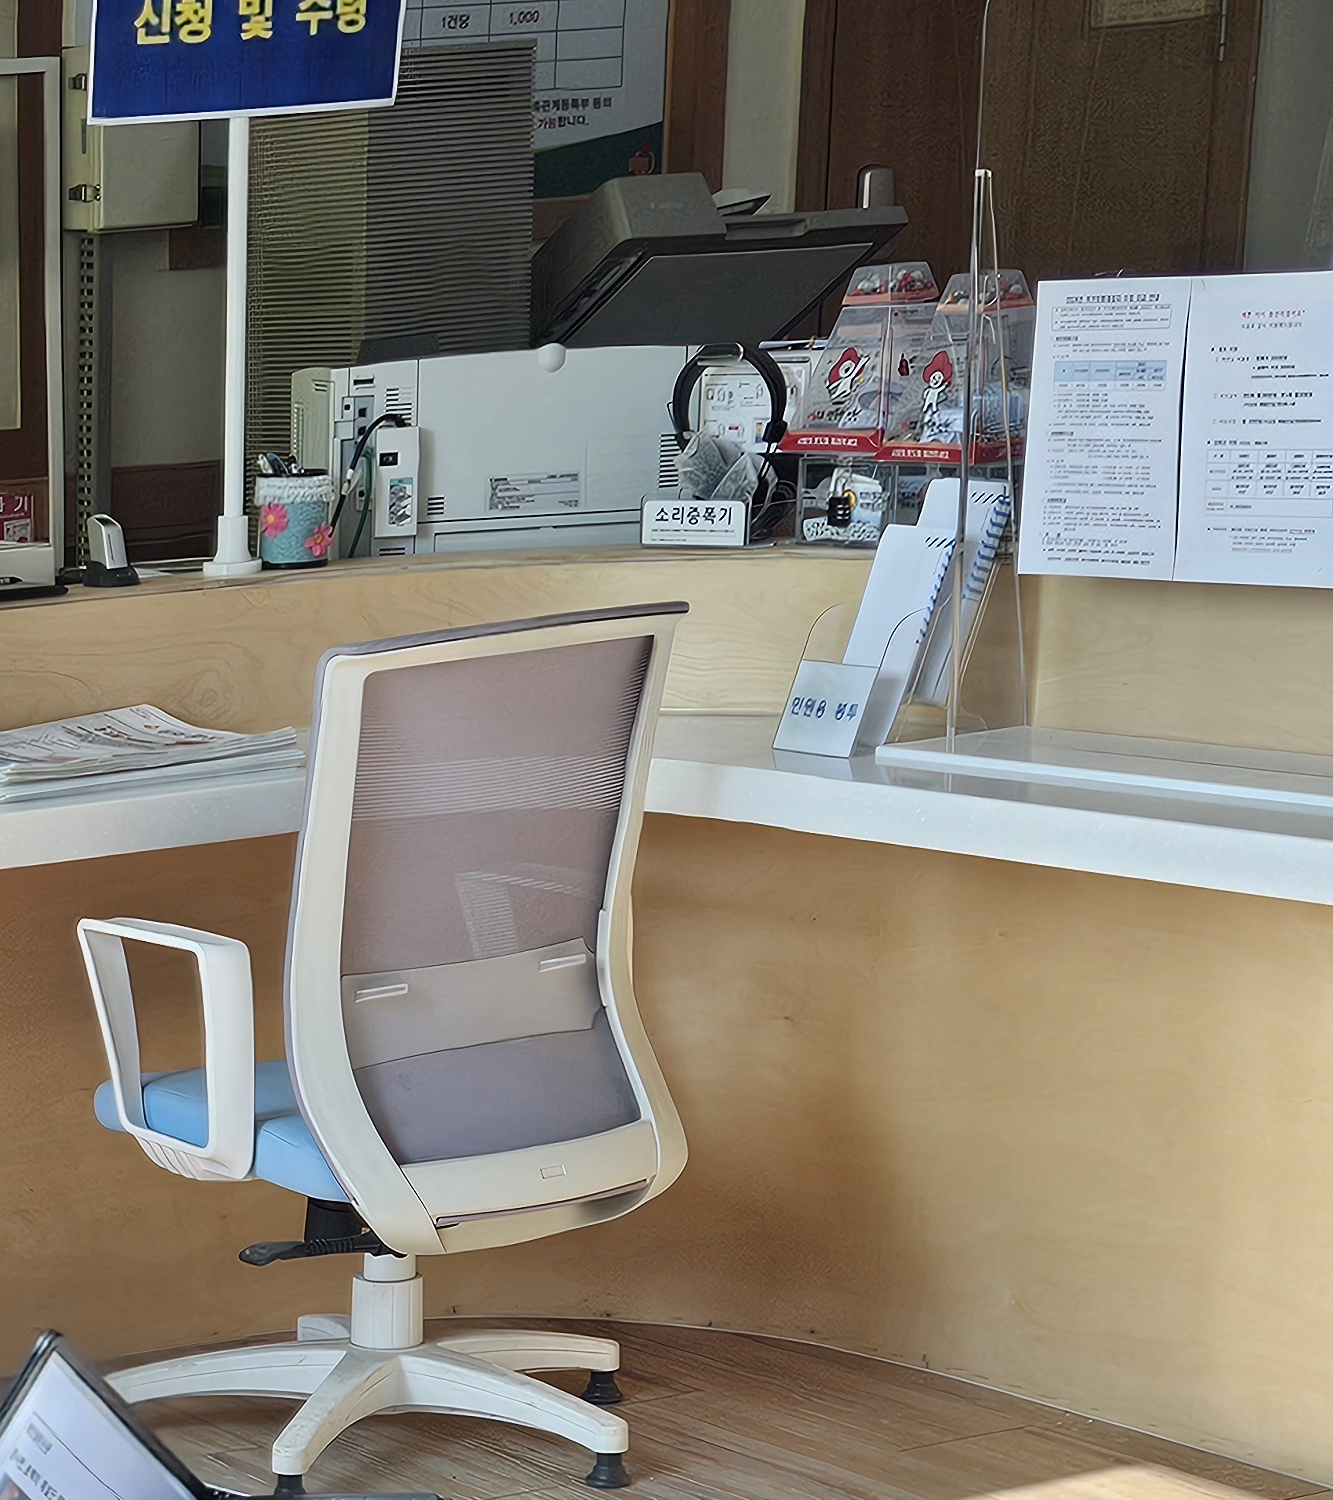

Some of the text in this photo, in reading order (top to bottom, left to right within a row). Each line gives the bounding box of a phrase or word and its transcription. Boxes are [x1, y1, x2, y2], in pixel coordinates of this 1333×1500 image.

[134, 0, 212, 45] 신청
[239, 0, 274, 40] 및
[654, 505, 733, 526] 소리증폭기
